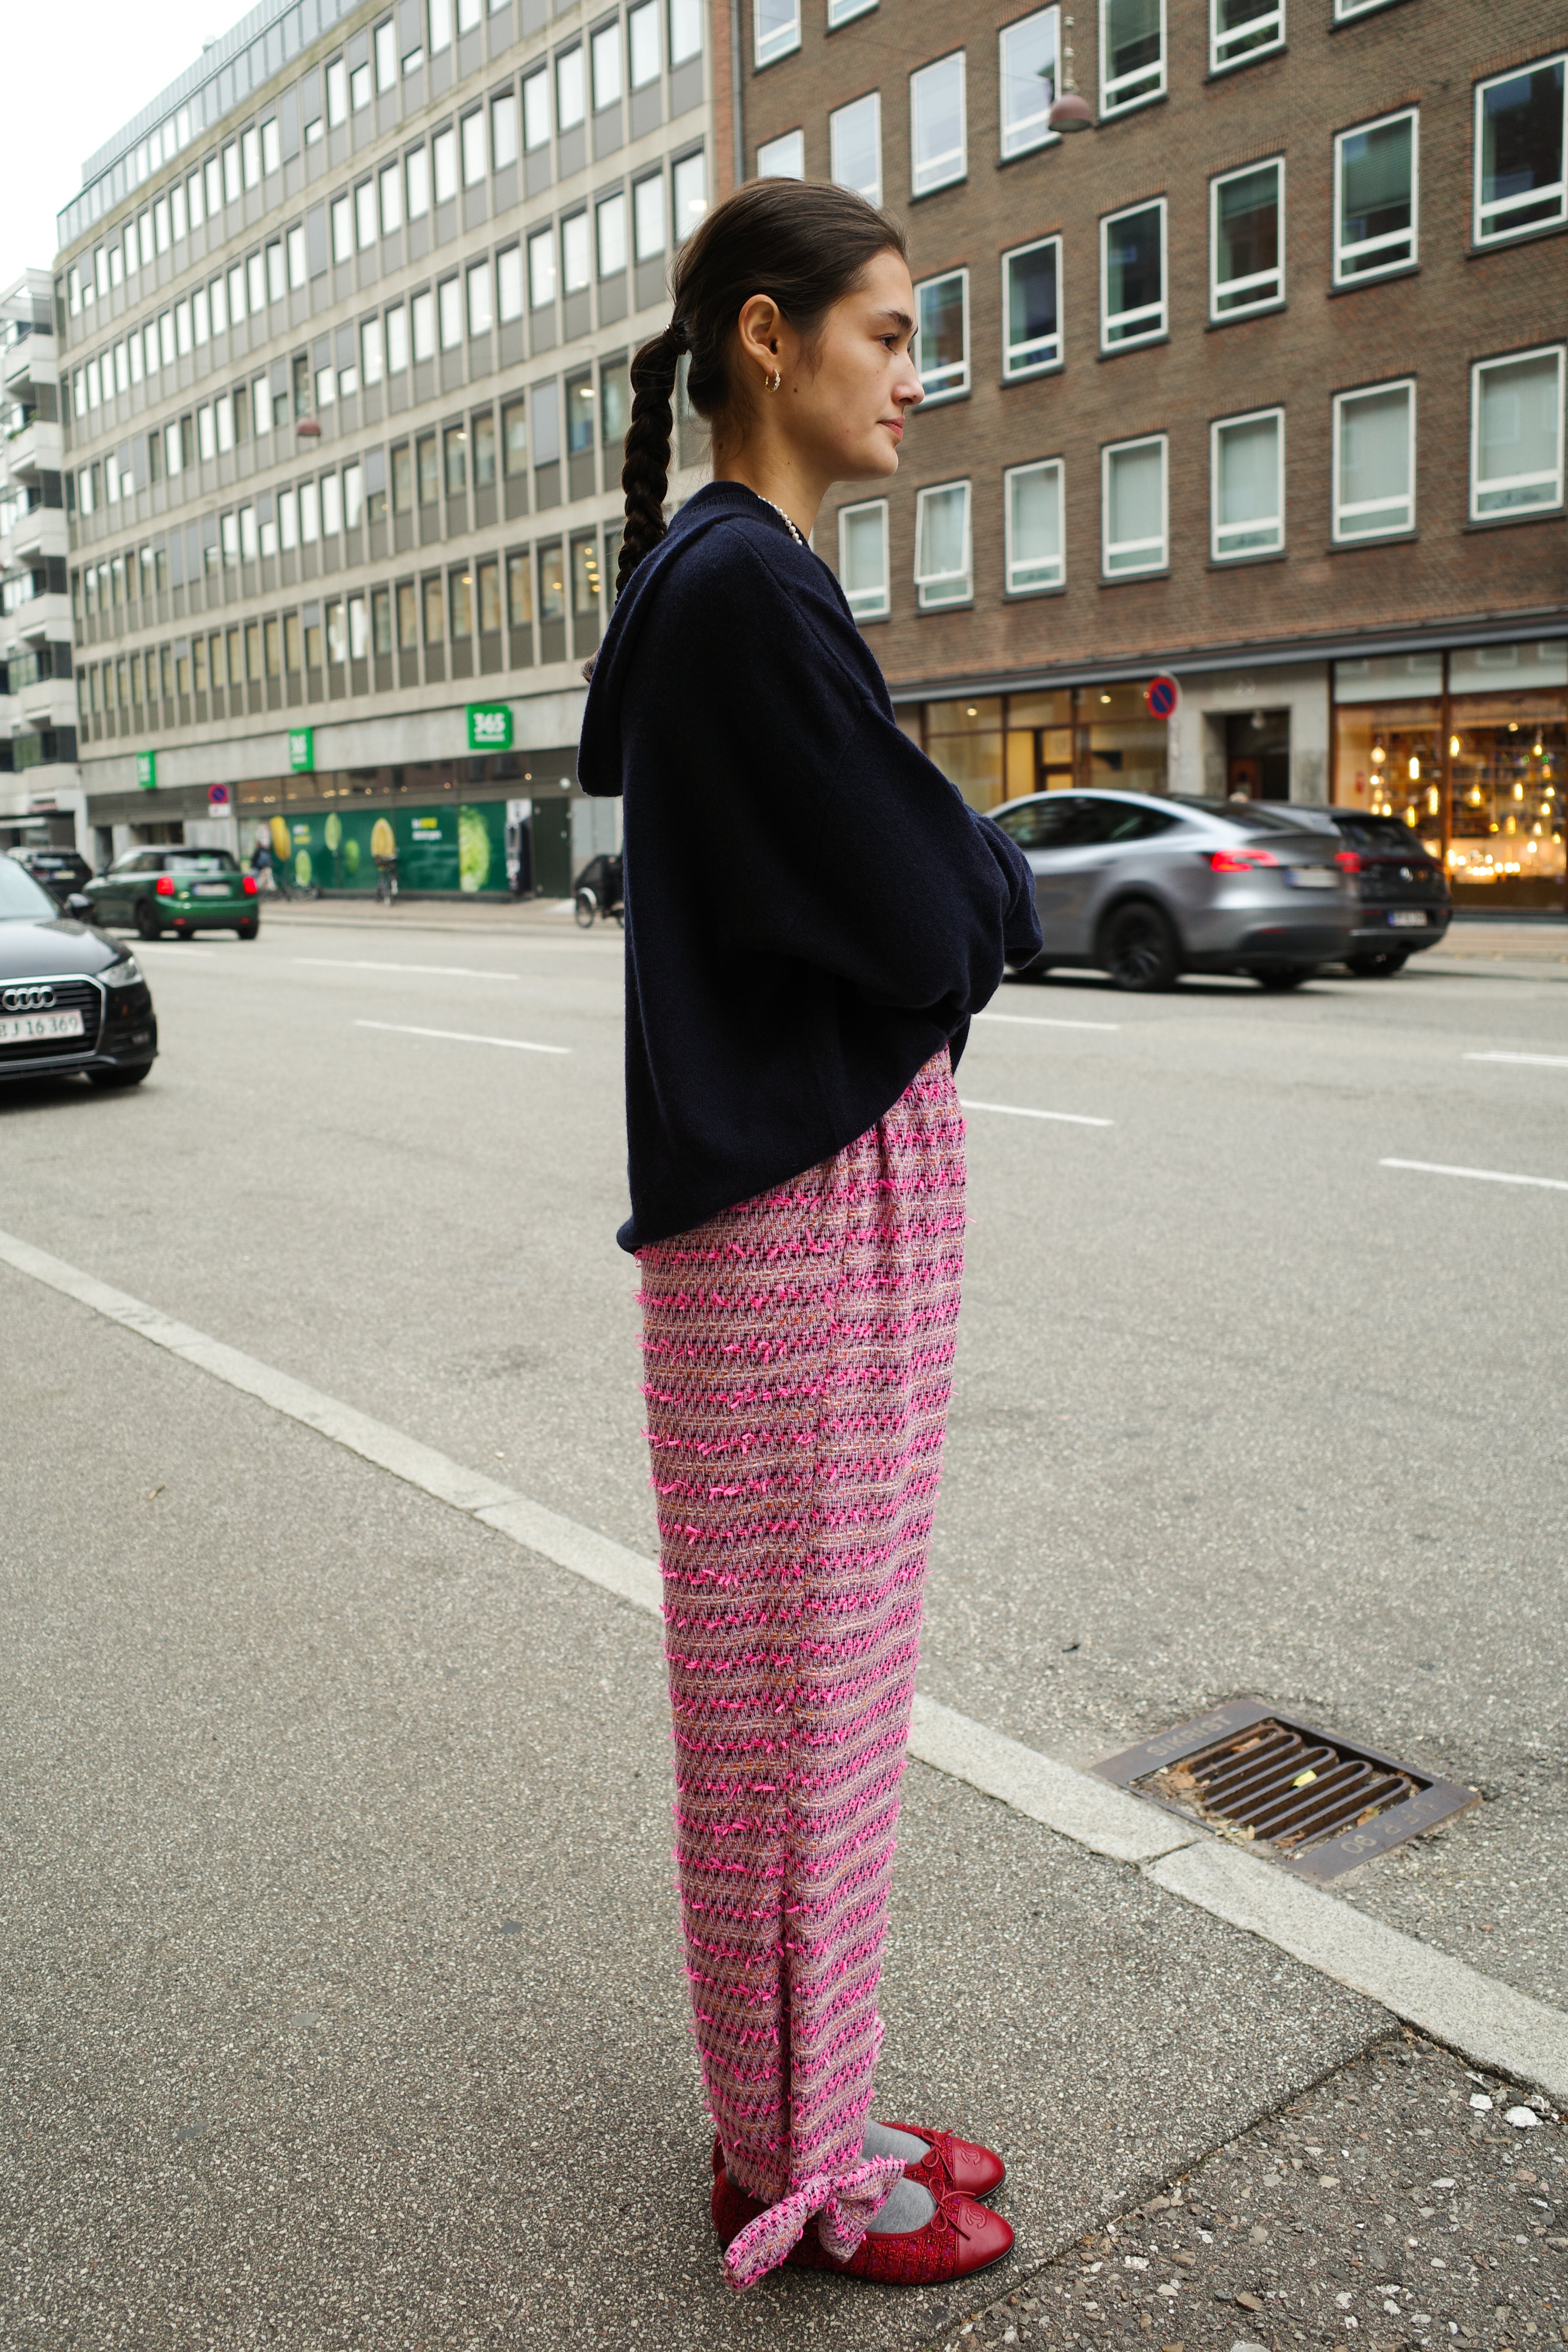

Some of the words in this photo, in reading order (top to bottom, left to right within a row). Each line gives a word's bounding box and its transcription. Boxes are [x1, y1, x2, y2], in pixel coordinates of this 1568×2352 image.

[473, 712, 506, 733] 365
[27, 1018, 45, 1035] 16
[49, 1016, 78, 1032] 369
[1146, 1714, 1232, 1757] SIKRIST
[1340, 1835, 1378, 1854] 90
